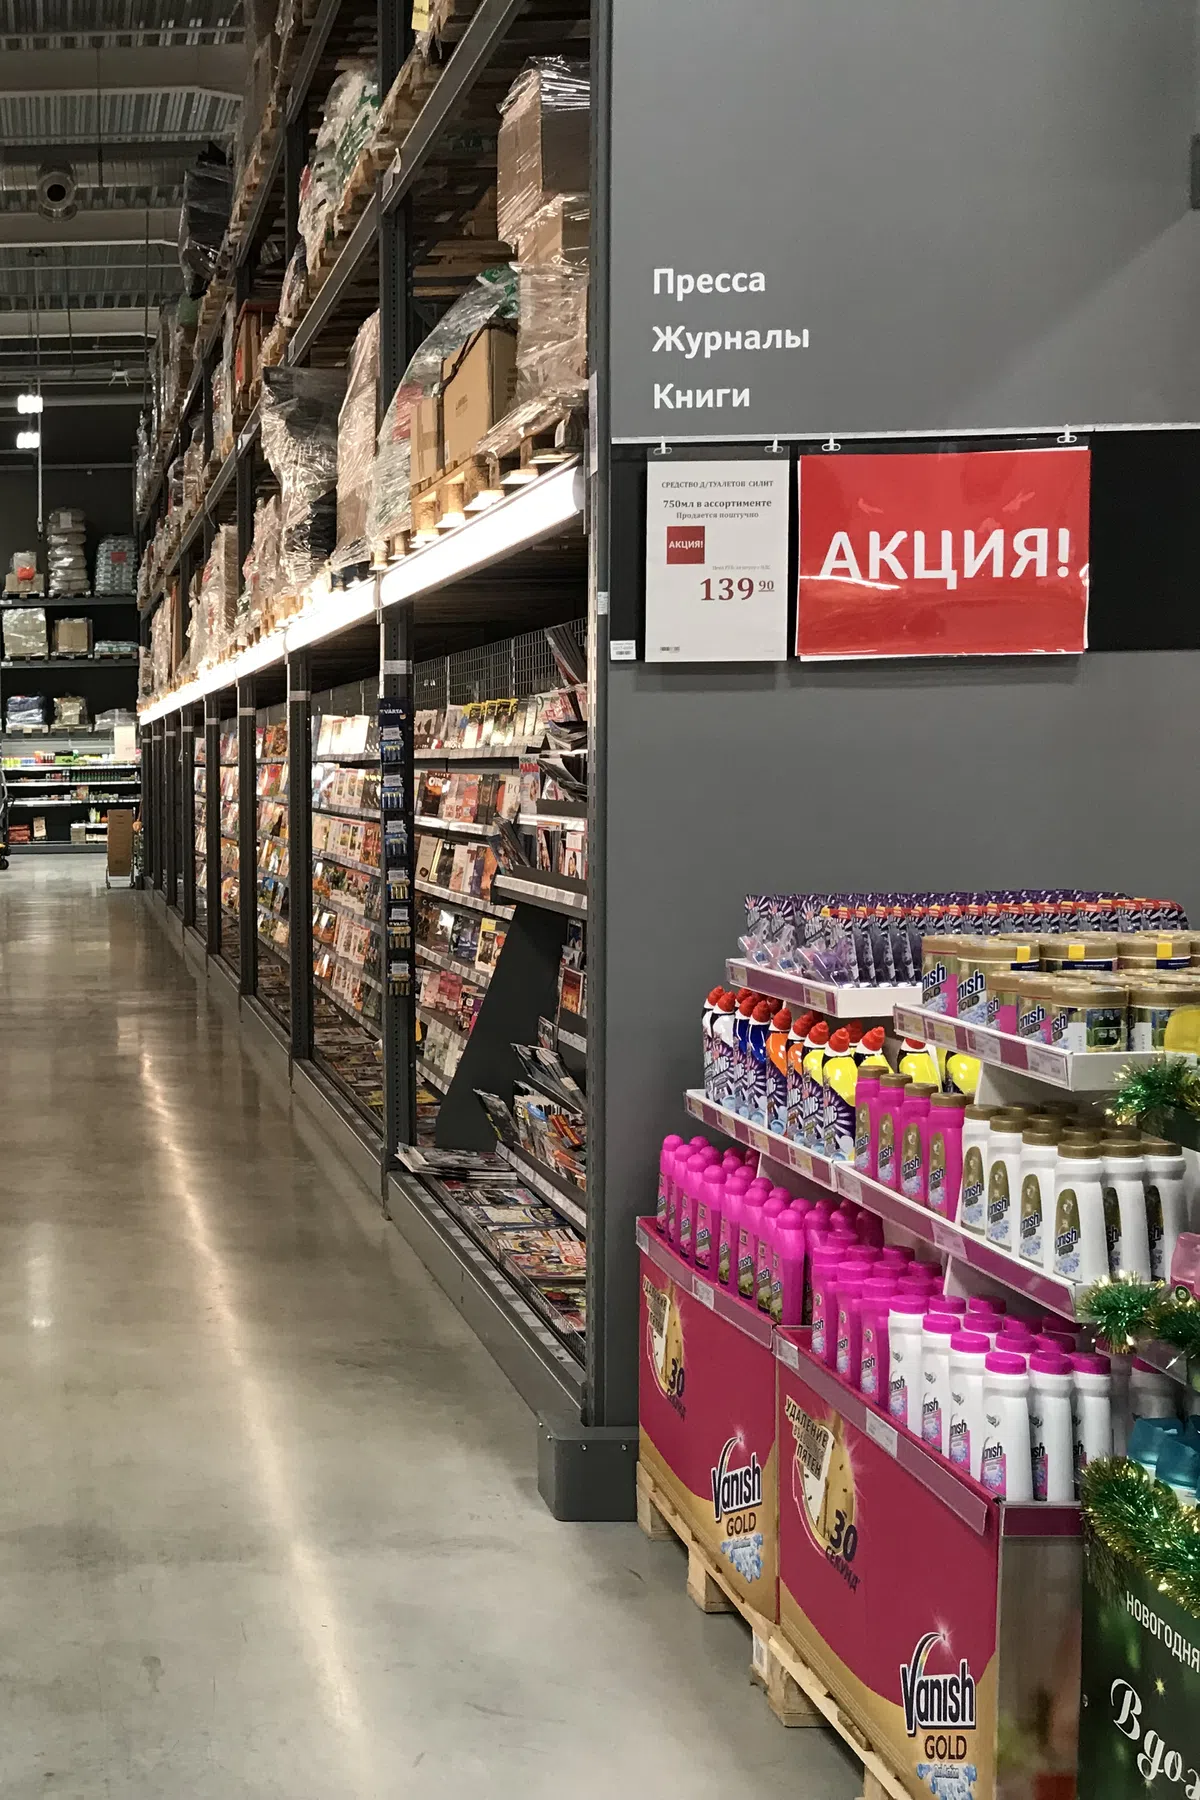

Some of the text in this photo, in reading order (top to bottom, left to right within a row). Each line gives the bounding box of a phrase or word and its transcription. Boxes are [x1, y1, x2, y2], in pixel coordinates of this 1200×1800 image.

[652, 268, 767, 301] Пресса
[652, 325, 810, 358] Журналы
[653, 384, 751, 410] Книги
[661, 481, 698, 489] СРЕДСТВО
[663, 500, 694, 508] 750мл
[704, 500, 772, 509] ассортименте
[676, 512, 717, 520] Продается
[669, 541, 703, 549] АКЦИЯ!
[819, 528, 1071, 590] АКЦИЯ!
[700, 577, 774, 601] 139 90
[922, 962, 946, 990] nish
[958, 970, 985, 999] nish
[669, 1358, 685, 1397] 30
[786, 1400, 829, 1448] УДАЛЕНИЕ
[796, 1443, 822, 1478] ПЯТЕН
[712, 1437, 761, 1520] Vanish
[726, 1512, 756, 1537] GOLD
[830, 1508, 858, 1562] 30
[900, 1632, 975, 1734] Vanish
[924, 1735, 967, 1760] GOLD
